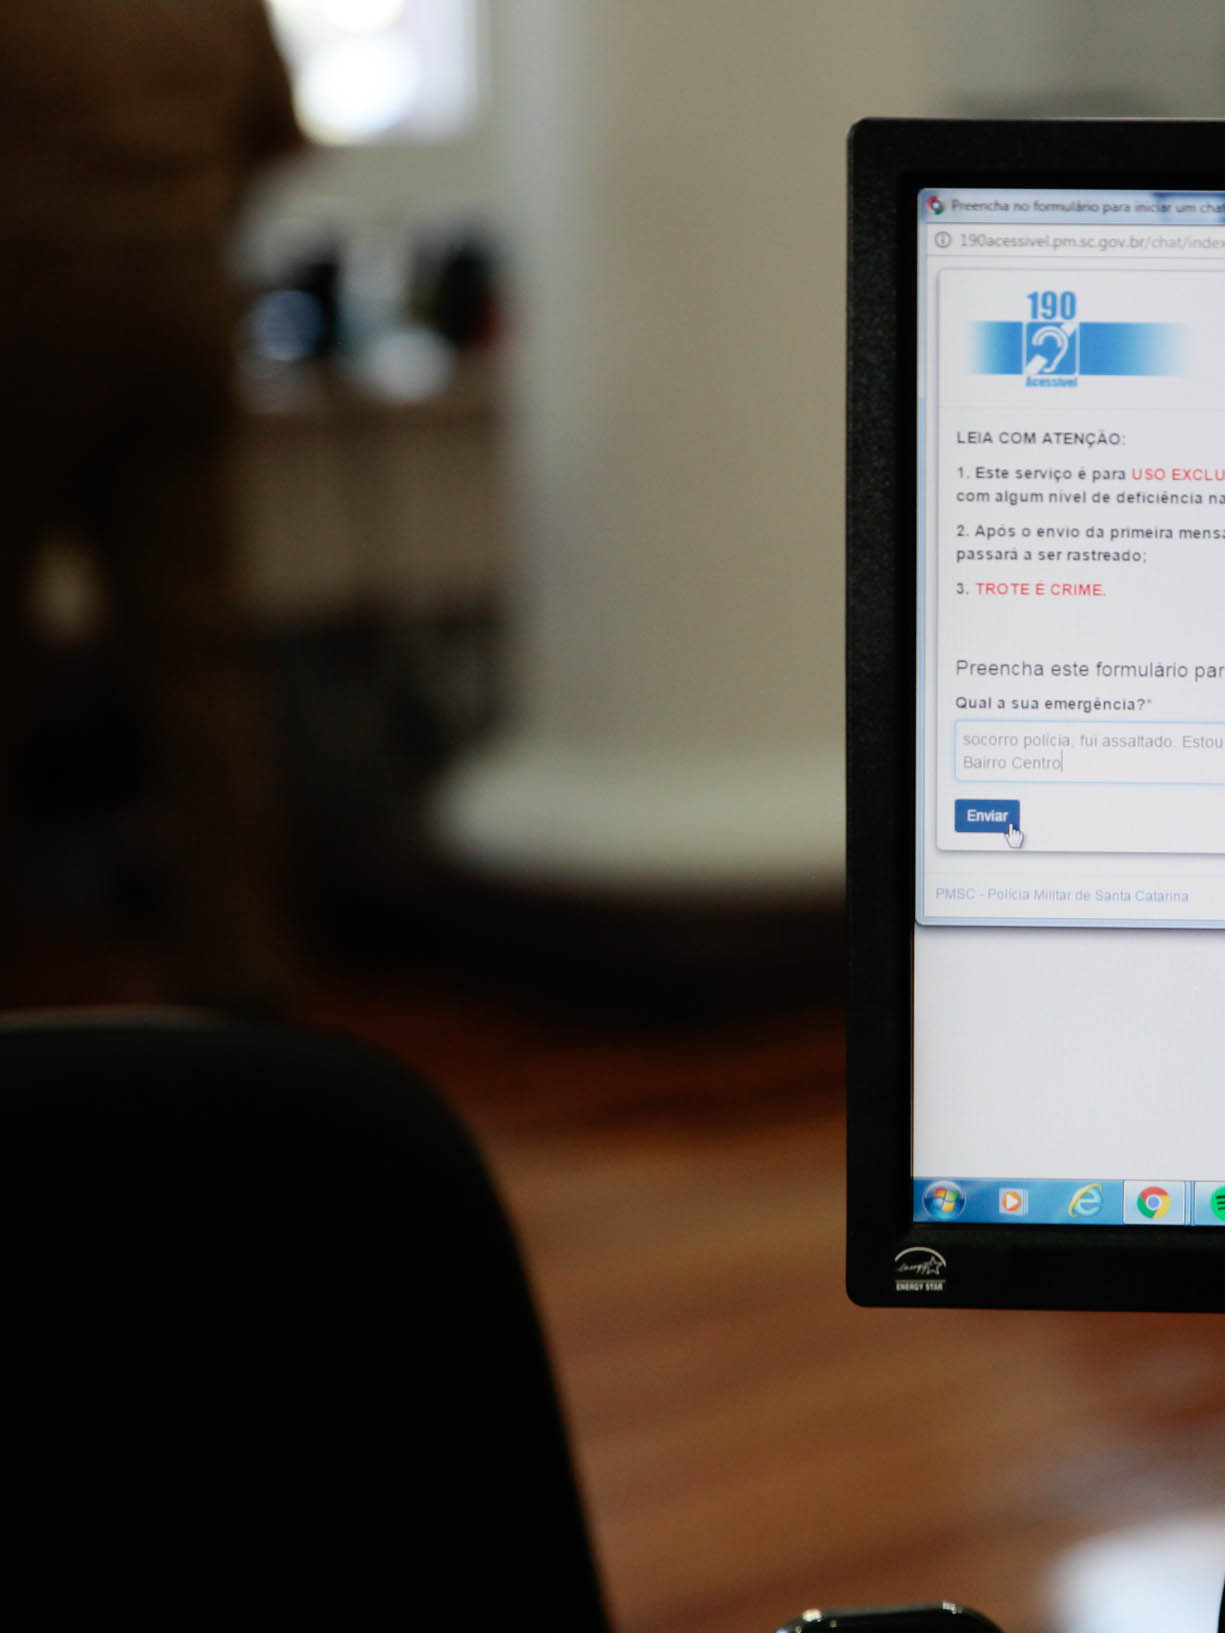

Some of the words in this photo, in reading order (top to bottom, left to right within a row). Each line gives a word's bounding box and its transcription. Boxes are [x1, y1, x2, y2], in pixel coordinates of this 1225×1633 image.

[951, 199, 1010, 214] Preencha
[1013, 202, 1029, 214] no
[1102, 203, 1131, 217] para
[1135, 200, 1172, 214] iniciar
[1176, 204, 1196, 215] um
[1026, 290, 1076, 320] 190
[956, 431, 994, 446] LEIA
[999, 431, 1037, 446] COM
[1042, 429, 1126, 450] ATENÇÃO:
[957, 467, 969, 481] 1.
[974, 467, 1009, 482] Este
[1015, 468, 1073, 486] serviço
[1078, 466, 1087, 482] é
[1092, 471, 1127, 486] para
[1131, 467, 1166, 482] USO
[956, 491, 989, 504] com
[994, 490, 1044, 508] algum
[1091, 490, 1111, 505] de
[1116, 489, 1202, 505] deficiência
[956, 525, 969, 539] 2.
[974, 524, 1015, 543] Após
[1021, 528, 1031, 540] o
[1036, 525, 1079, 540] envio
[1085, 525, 1104, 540] da
[1110, 526, 1174, 544] primeira
[956, 547, 1018, 564] passará
[1023, 550, 1033, 562] a
[1038, 550, 1062, 562] ser
[1067, 548, 1147, 564] rastreado;
[956, 583, 969, 597] 3.
[975, 582, 1030, 597] TROTE
[1035, 579, 1045, 597] É
[1050, 582, 1106, 598] CRIME.
[956, 659, 1045, 678] Preencha
[1051, 662, 1090, 678] este
[1095, 659, 1189, 679] formulário
[955, 696, 992, 711] Qual
[997, 700, 1006, 711] a
[1011, 700, 1040, 711] sua
[963, 733, 1019, 747] socorro
[1079, 732, 1098, 748] fui
[1182, 734, 1222, 750] Estou
[963, 756, 1006, 770] Bairro
[1011, 756, 1061, 770] Centro
[966, 807, 1008, 823] Enviar
[935, 887, 975, 902] PMSC
[987, 886, 1030, 903] Polícia
[1033, 888, 1072, 903] Militar
[1075, 889, 1091, 903] de
[1095, 888, 1131, 903] Santa
[1134, 888, 1189, 904] Catarina
[896, 1282, 923, 1292] ENERGY
[925, 1282, 943, 1292] STAR
